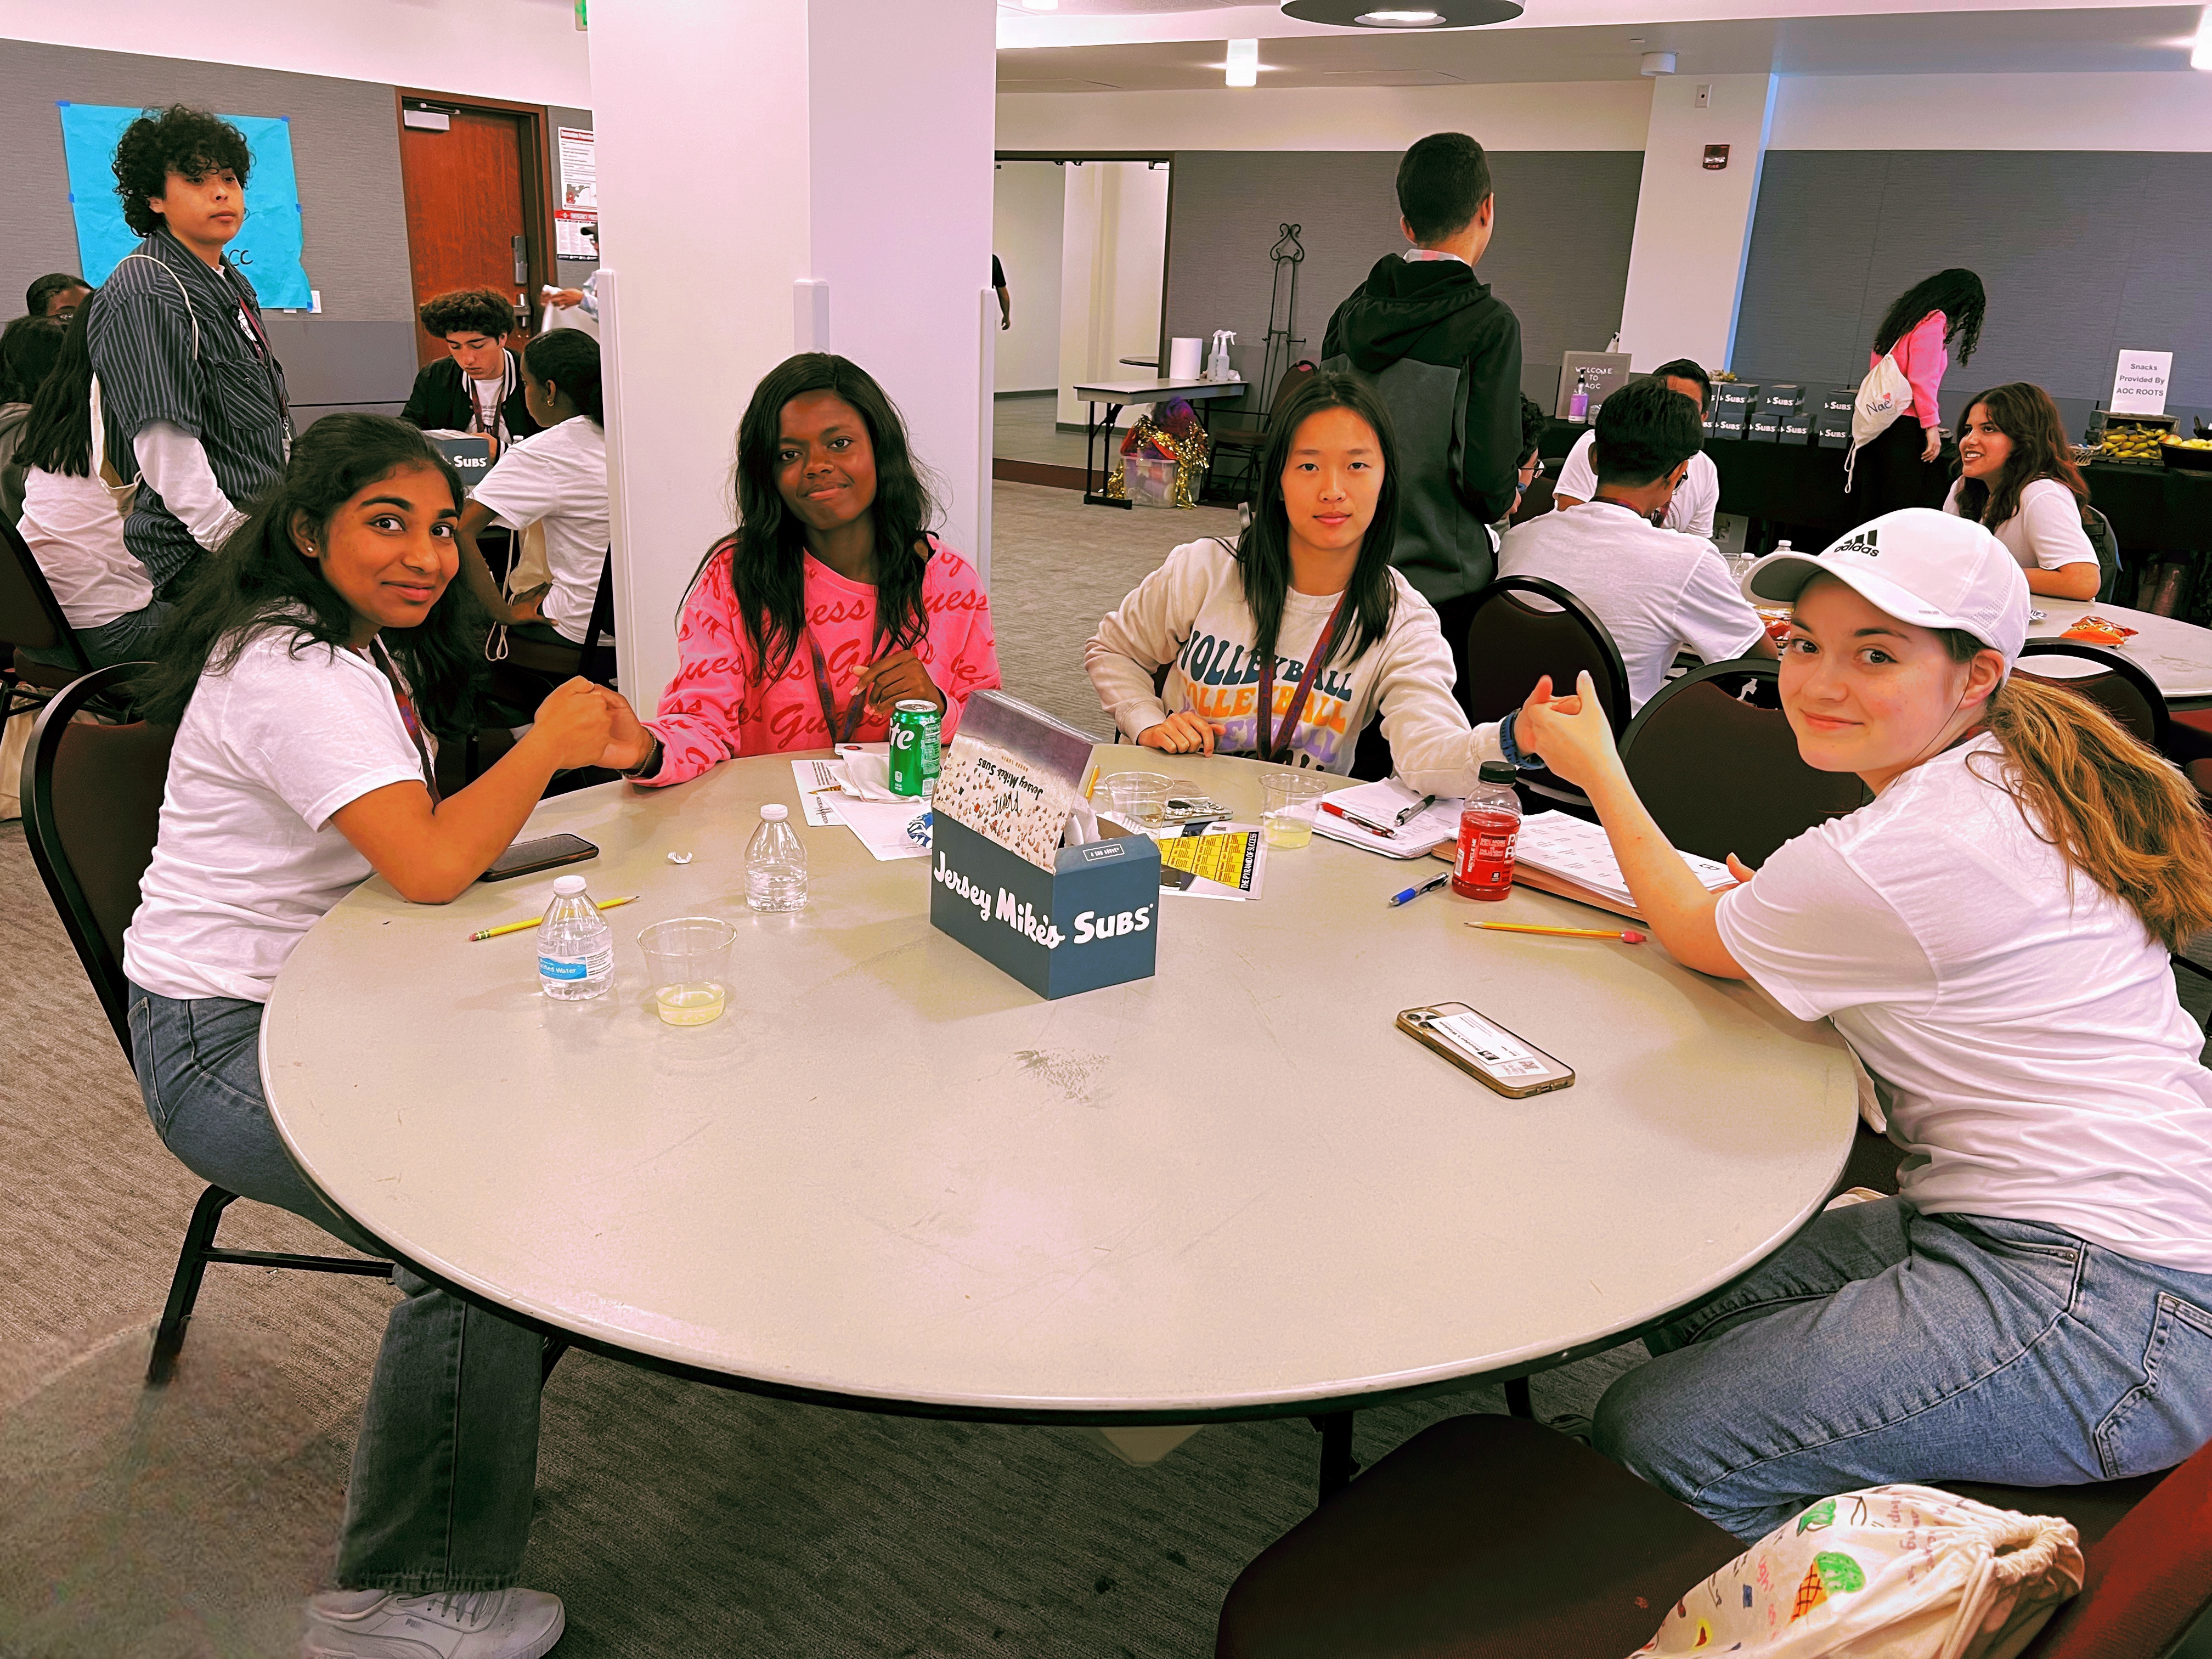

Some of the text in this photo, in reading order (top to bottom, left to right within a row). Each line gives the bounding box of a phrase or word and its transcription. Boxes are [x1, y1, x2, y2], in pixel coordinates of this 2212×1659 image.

[1866, 400, 1893, 416] Nae
[454, 455, 487, 467] SUBS
[1834, 542, 1880, 557] adidas
[805, 599, 871, 627] ess
[923, 589, 989, 614] uess
[1183, 676, 1346, 735] OLLEBALL
[889, 716, 915, 750] ite
[997, 768, 1019, 788] Mike's
[1019, 775, 1043, 800] Jersey
[1247, 833, 1257, 851] SUCCESS
[1468, 838, 1477, 872] RECYCLE ME
[1243, 858, 1252, 879] PYRAMID
[1241, 879, 1250, 889] THE
[933, 850, 992, 921] Jersey
[996, 887, 1066, 950] Mike's
